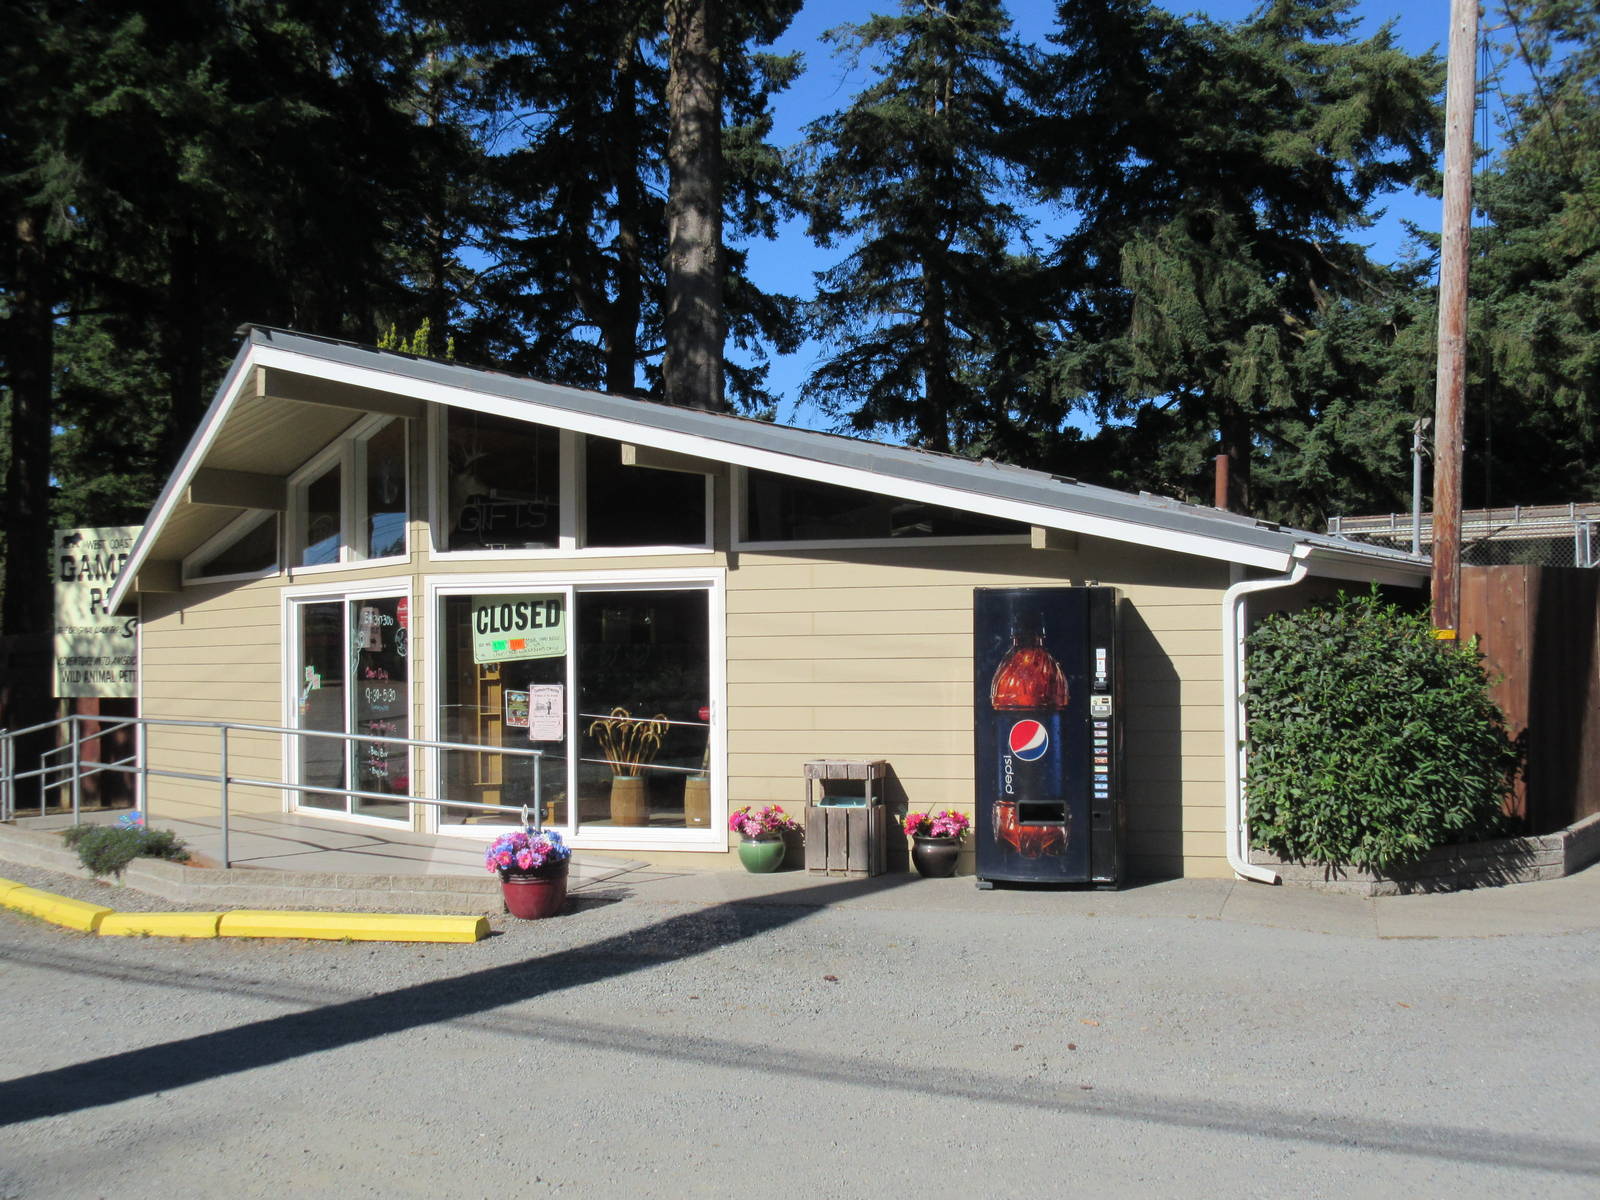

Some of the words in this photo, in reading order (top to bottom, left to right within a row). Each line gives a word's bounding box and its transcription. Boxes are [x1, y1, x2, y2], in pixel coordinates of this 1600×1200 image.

[459, 503, 546, 531] GIFTS
[476, 599, 561, 635] CLOSED
[83, 669, 115, 683] ANIMAL
[1003, 755, 1014, 794] pepsi
